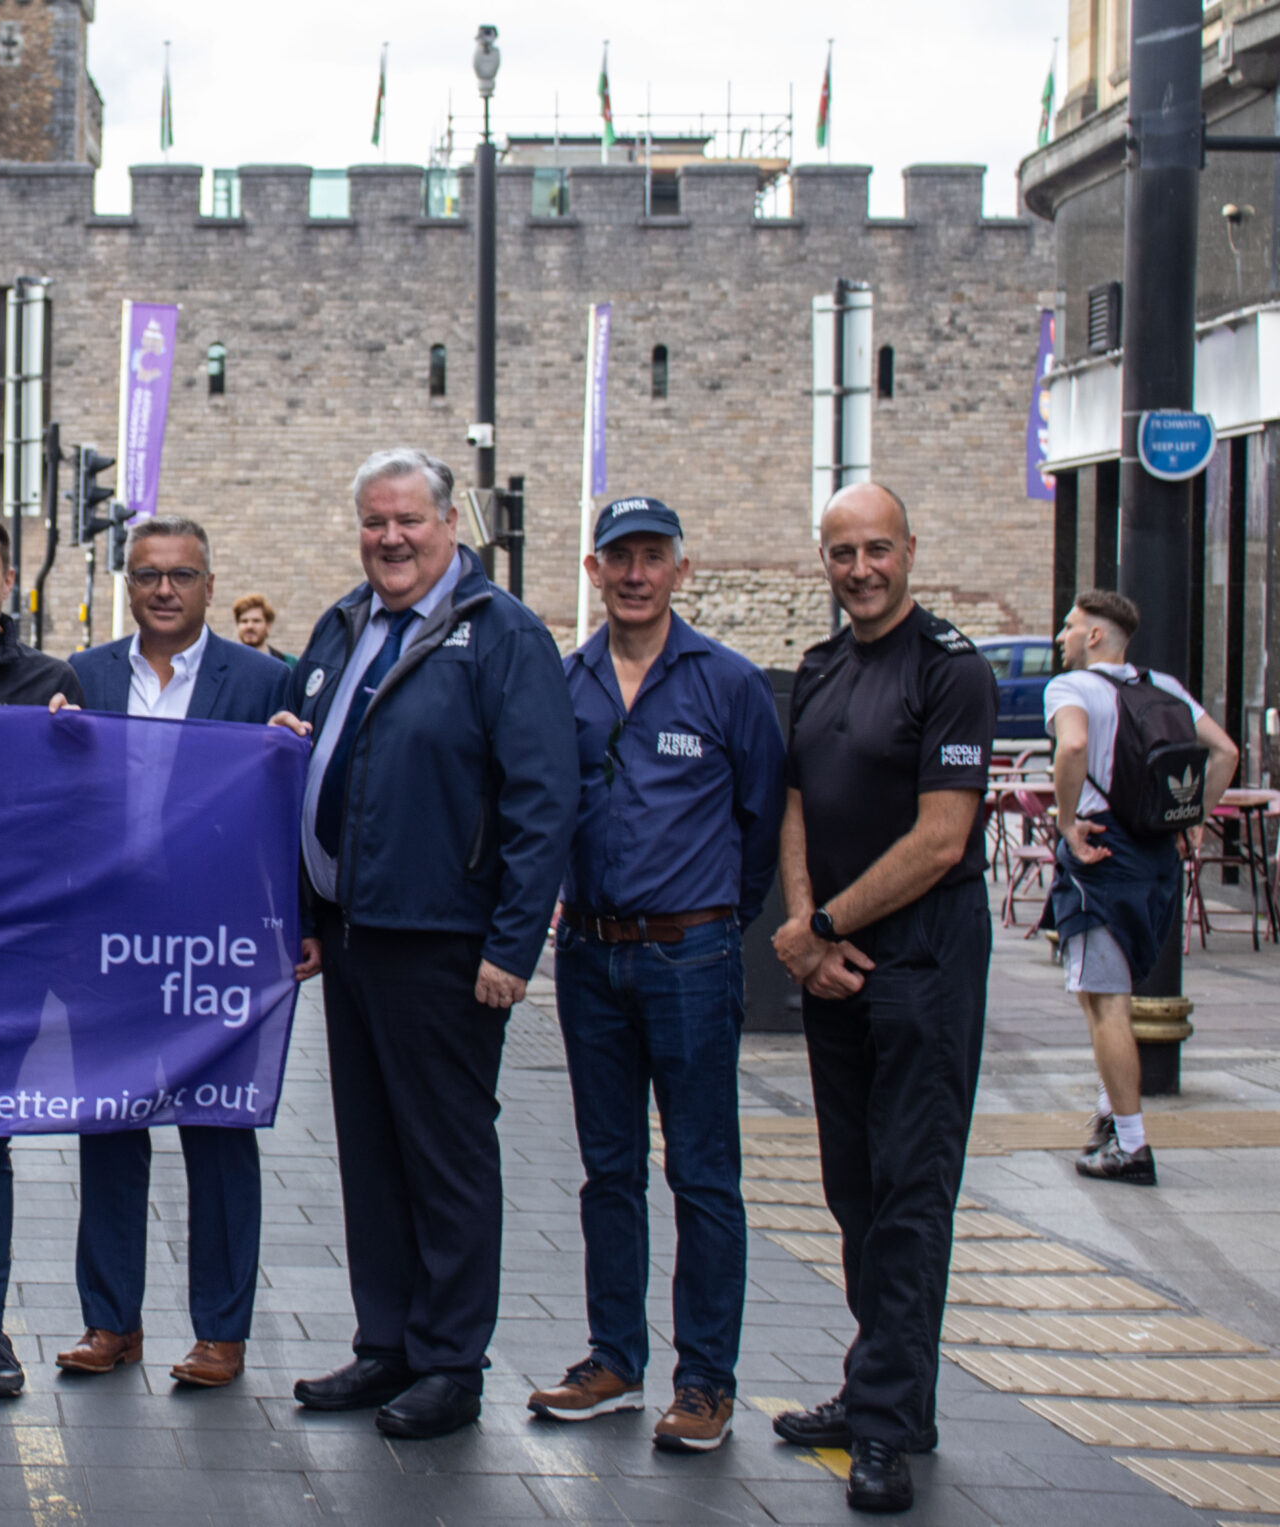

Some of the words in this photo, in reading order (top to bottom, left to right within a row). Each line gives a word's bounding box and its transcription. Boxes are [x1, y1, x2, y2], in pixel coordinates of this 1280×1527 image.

[658, 732, 701, 746] STREET
[657, 744, 702, 757] PASTOR
[941, 744, 981, 755] HEDDLU
[941, 754, 981, 766] POLICE
[101, 925, 257, 982] purple
[161, 971, 251, 1028] flag
[96, 1088, 187, 1123] night
[194, 1082, 260, 1113] out
